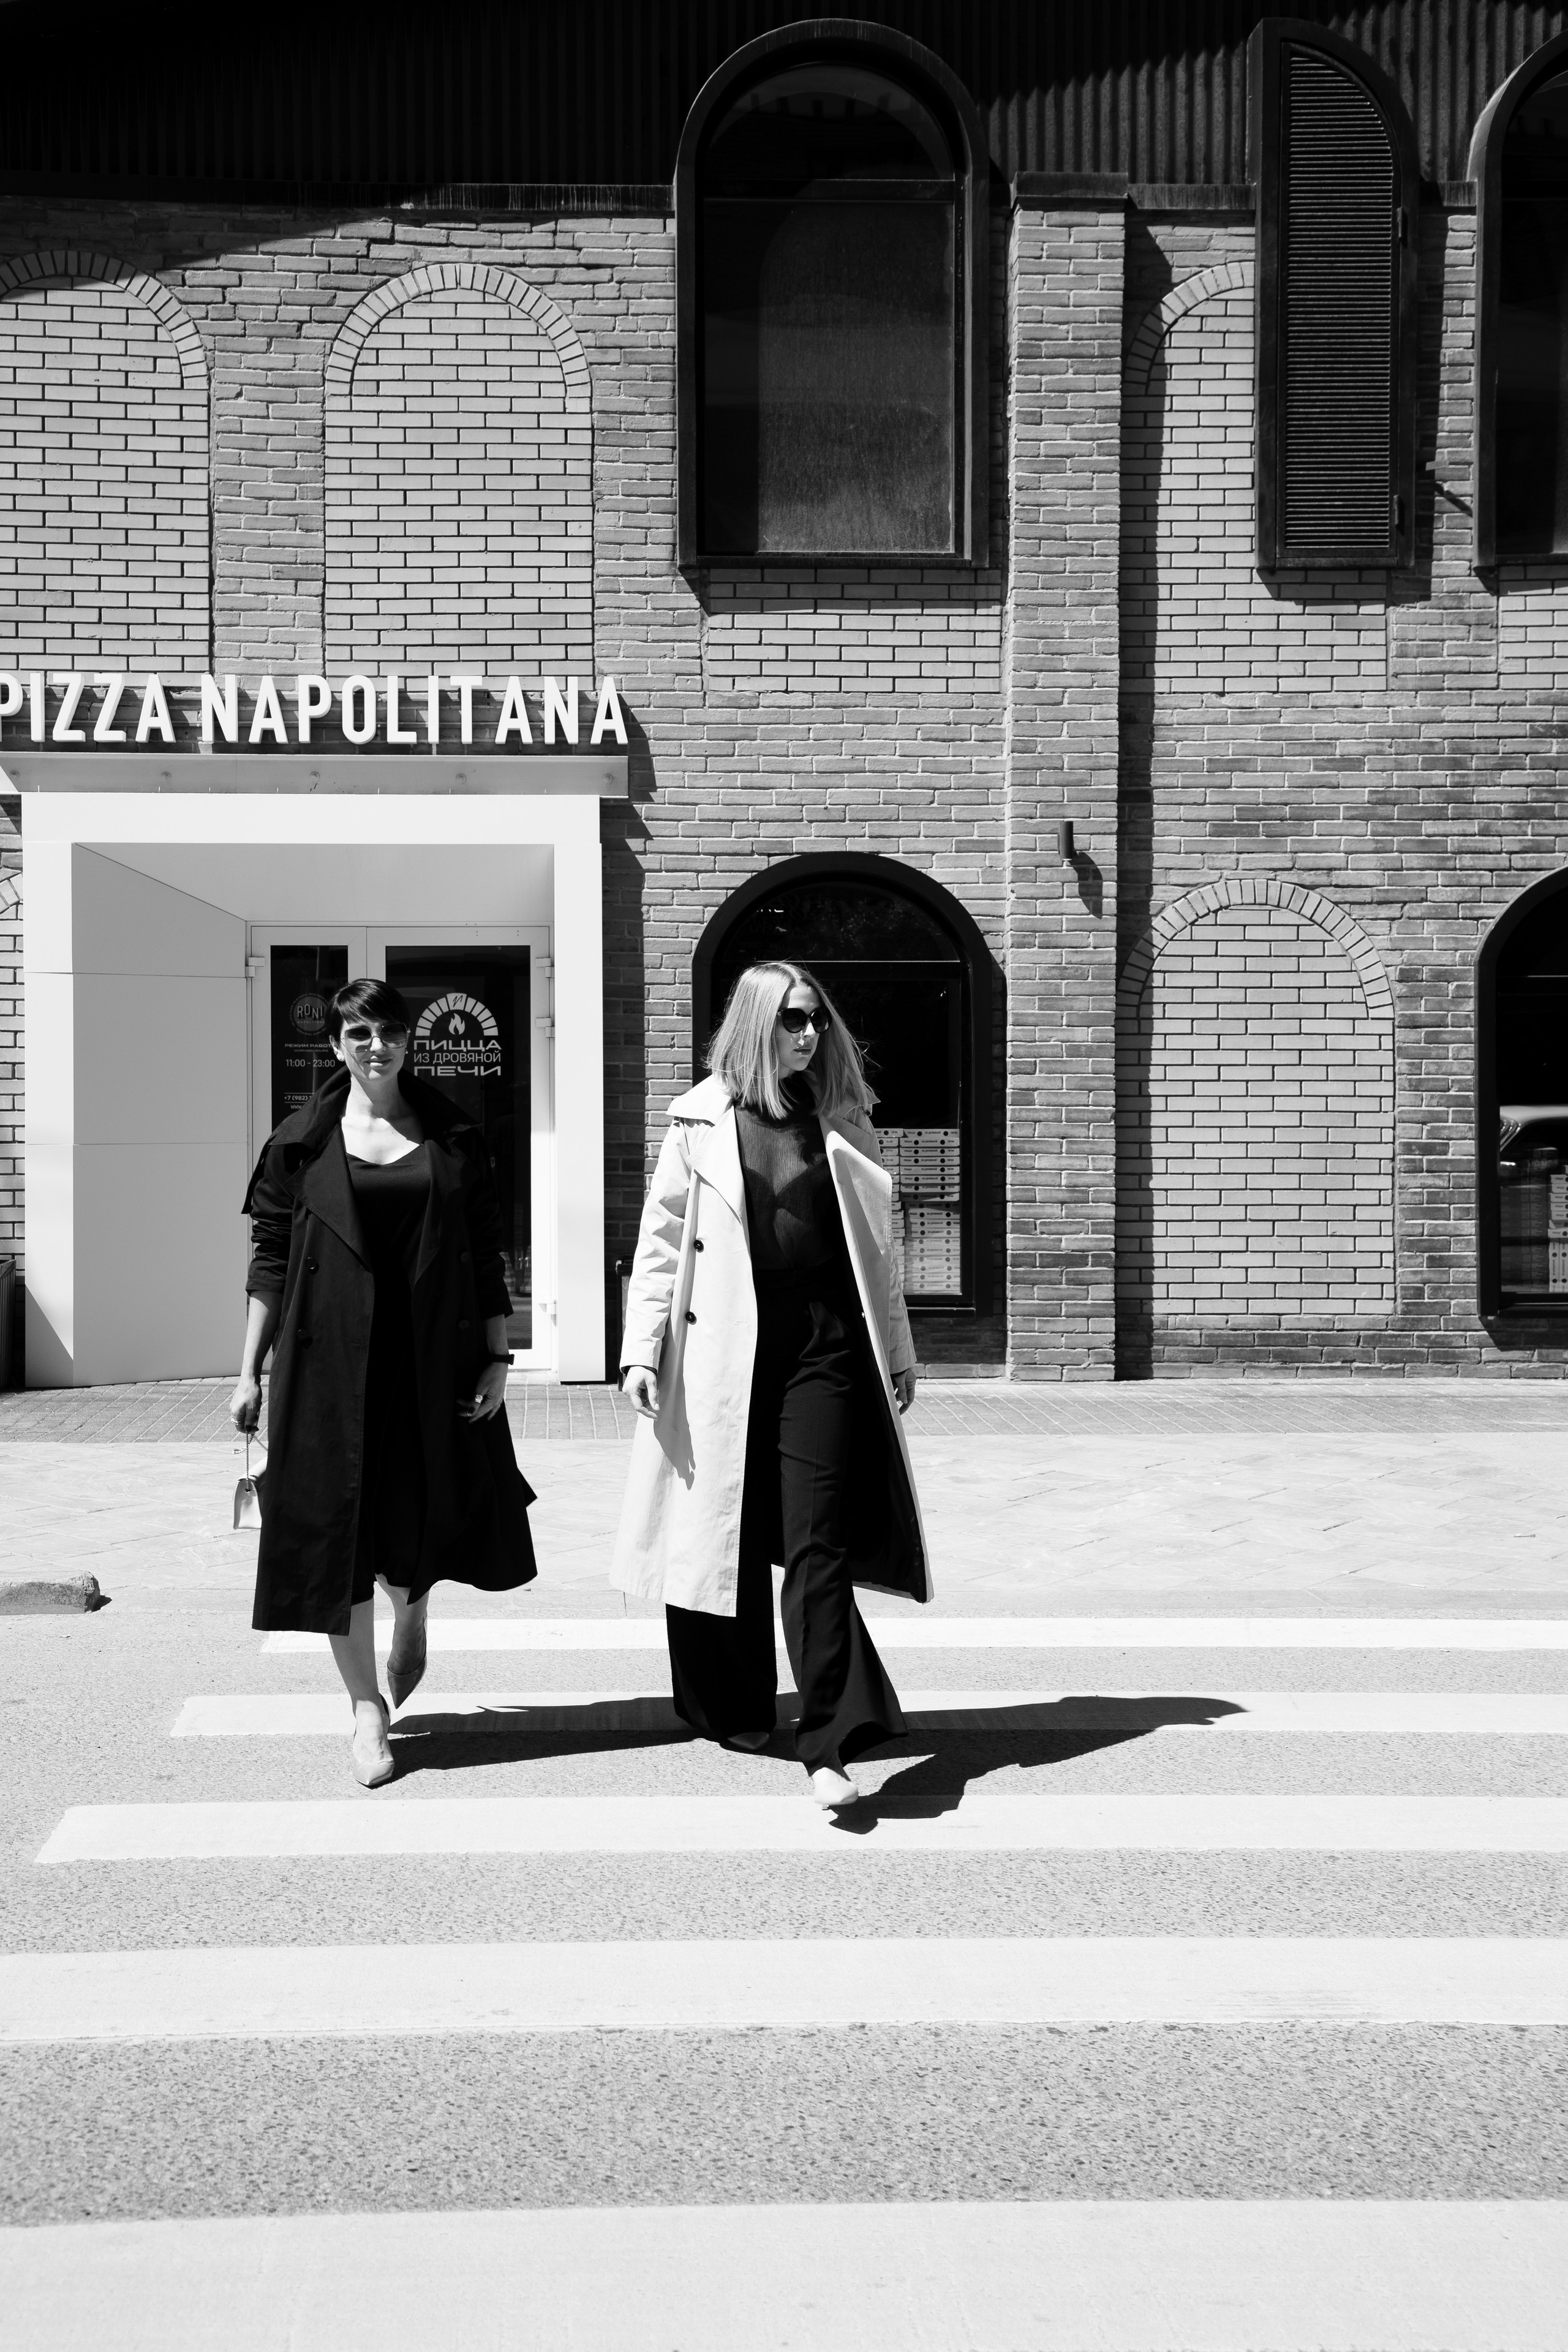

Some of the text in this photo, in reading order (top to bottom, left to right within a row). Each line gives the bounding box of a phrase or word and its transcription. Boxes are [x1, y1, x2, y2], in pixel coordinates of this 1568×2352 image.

[0, 673, 628, 745] PIZZA NAPOLITANA
[297, 1003, 323, 1019] RONI
[413, 1039, 502, 1052] ПИЦЦА
[313, 1059, 336, 1068] 23:00
[413, 1050, 501, 1065] ИЗ ДРОВЯНОЙ
[414, 1066, 502, 1076] ПЕЧИ
